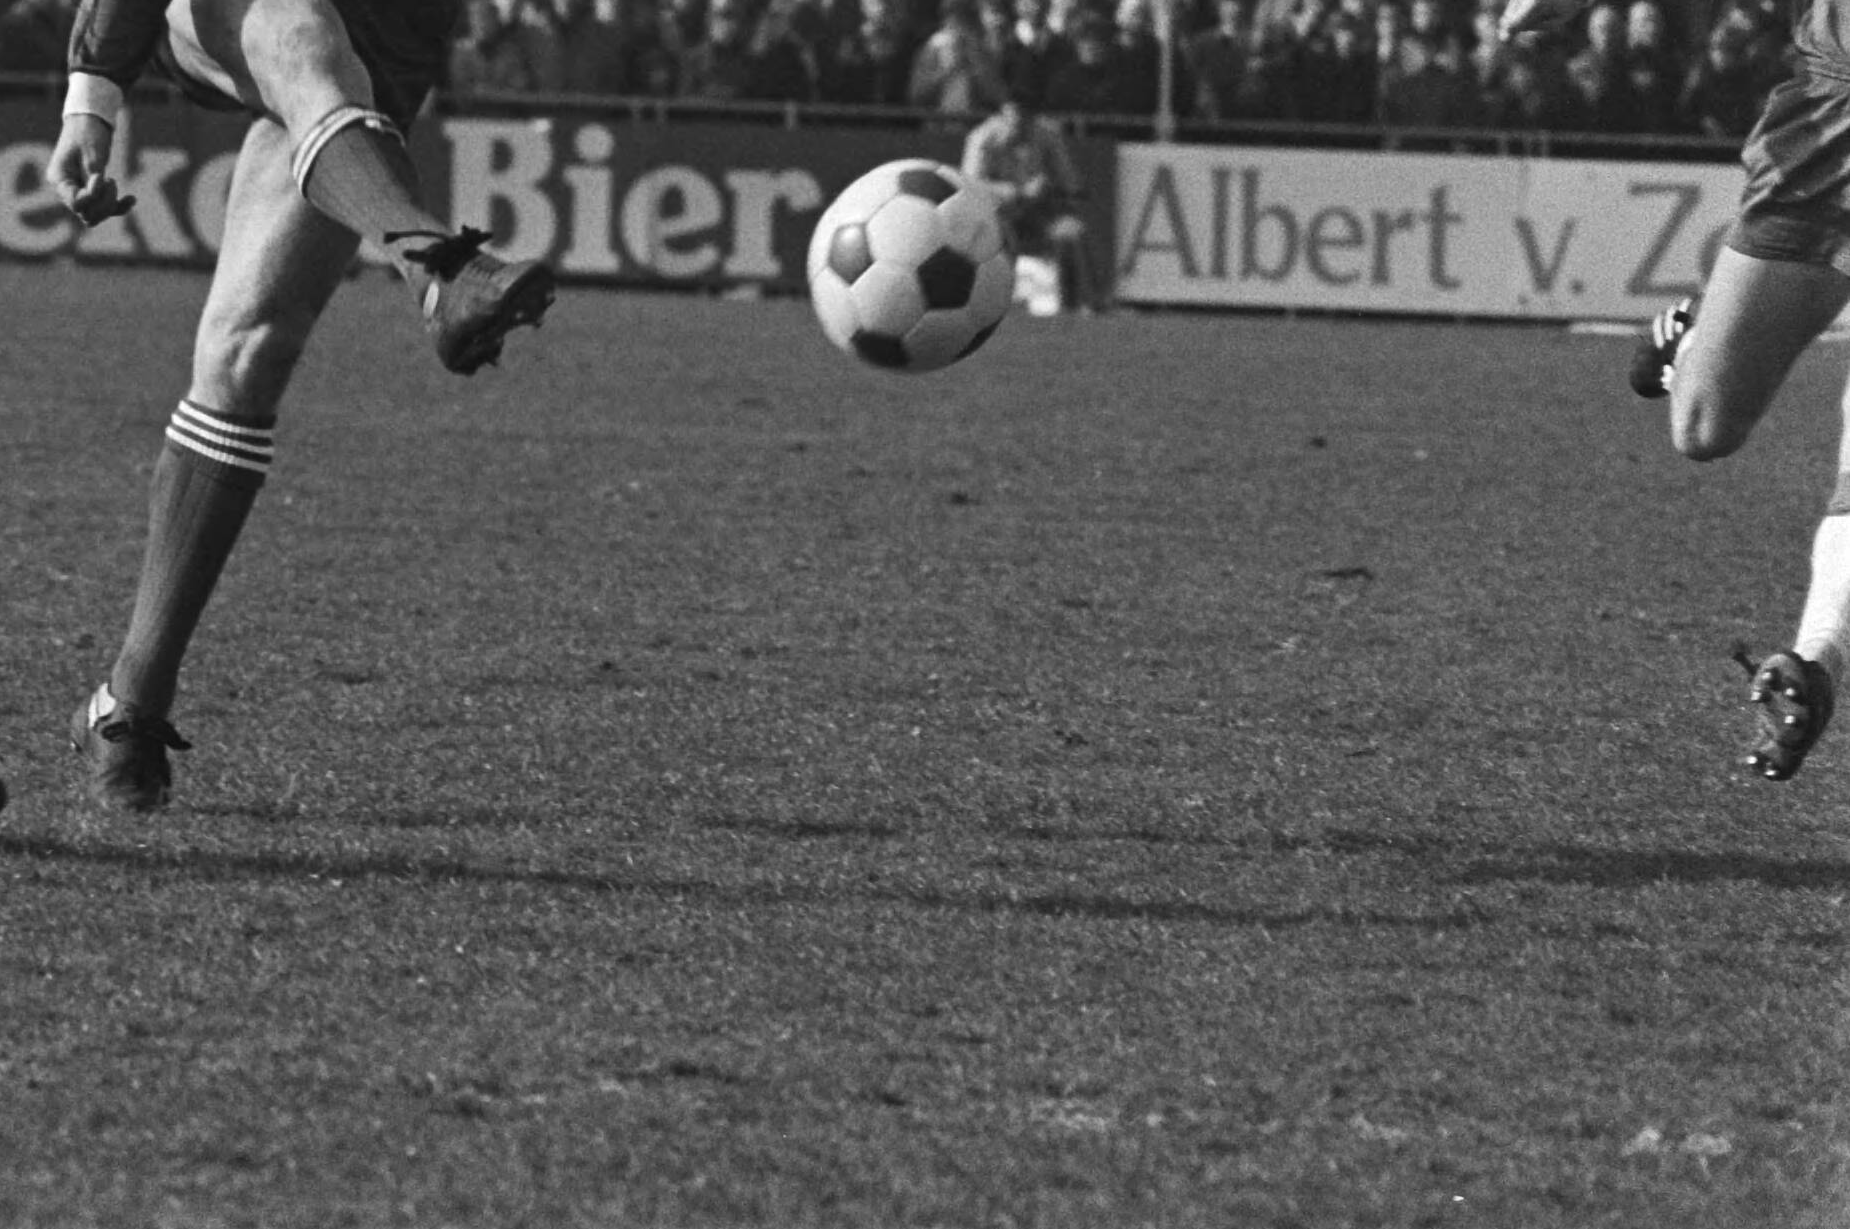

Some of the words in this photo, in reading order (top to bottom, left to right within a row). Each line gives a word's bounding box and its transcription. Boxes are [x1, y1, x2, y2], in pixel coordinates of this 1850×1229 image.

[444, 117, 823, 278] Bier
[1119, 165, 1465, 291] Albert
[1515, 215, 1585, 297] v.
